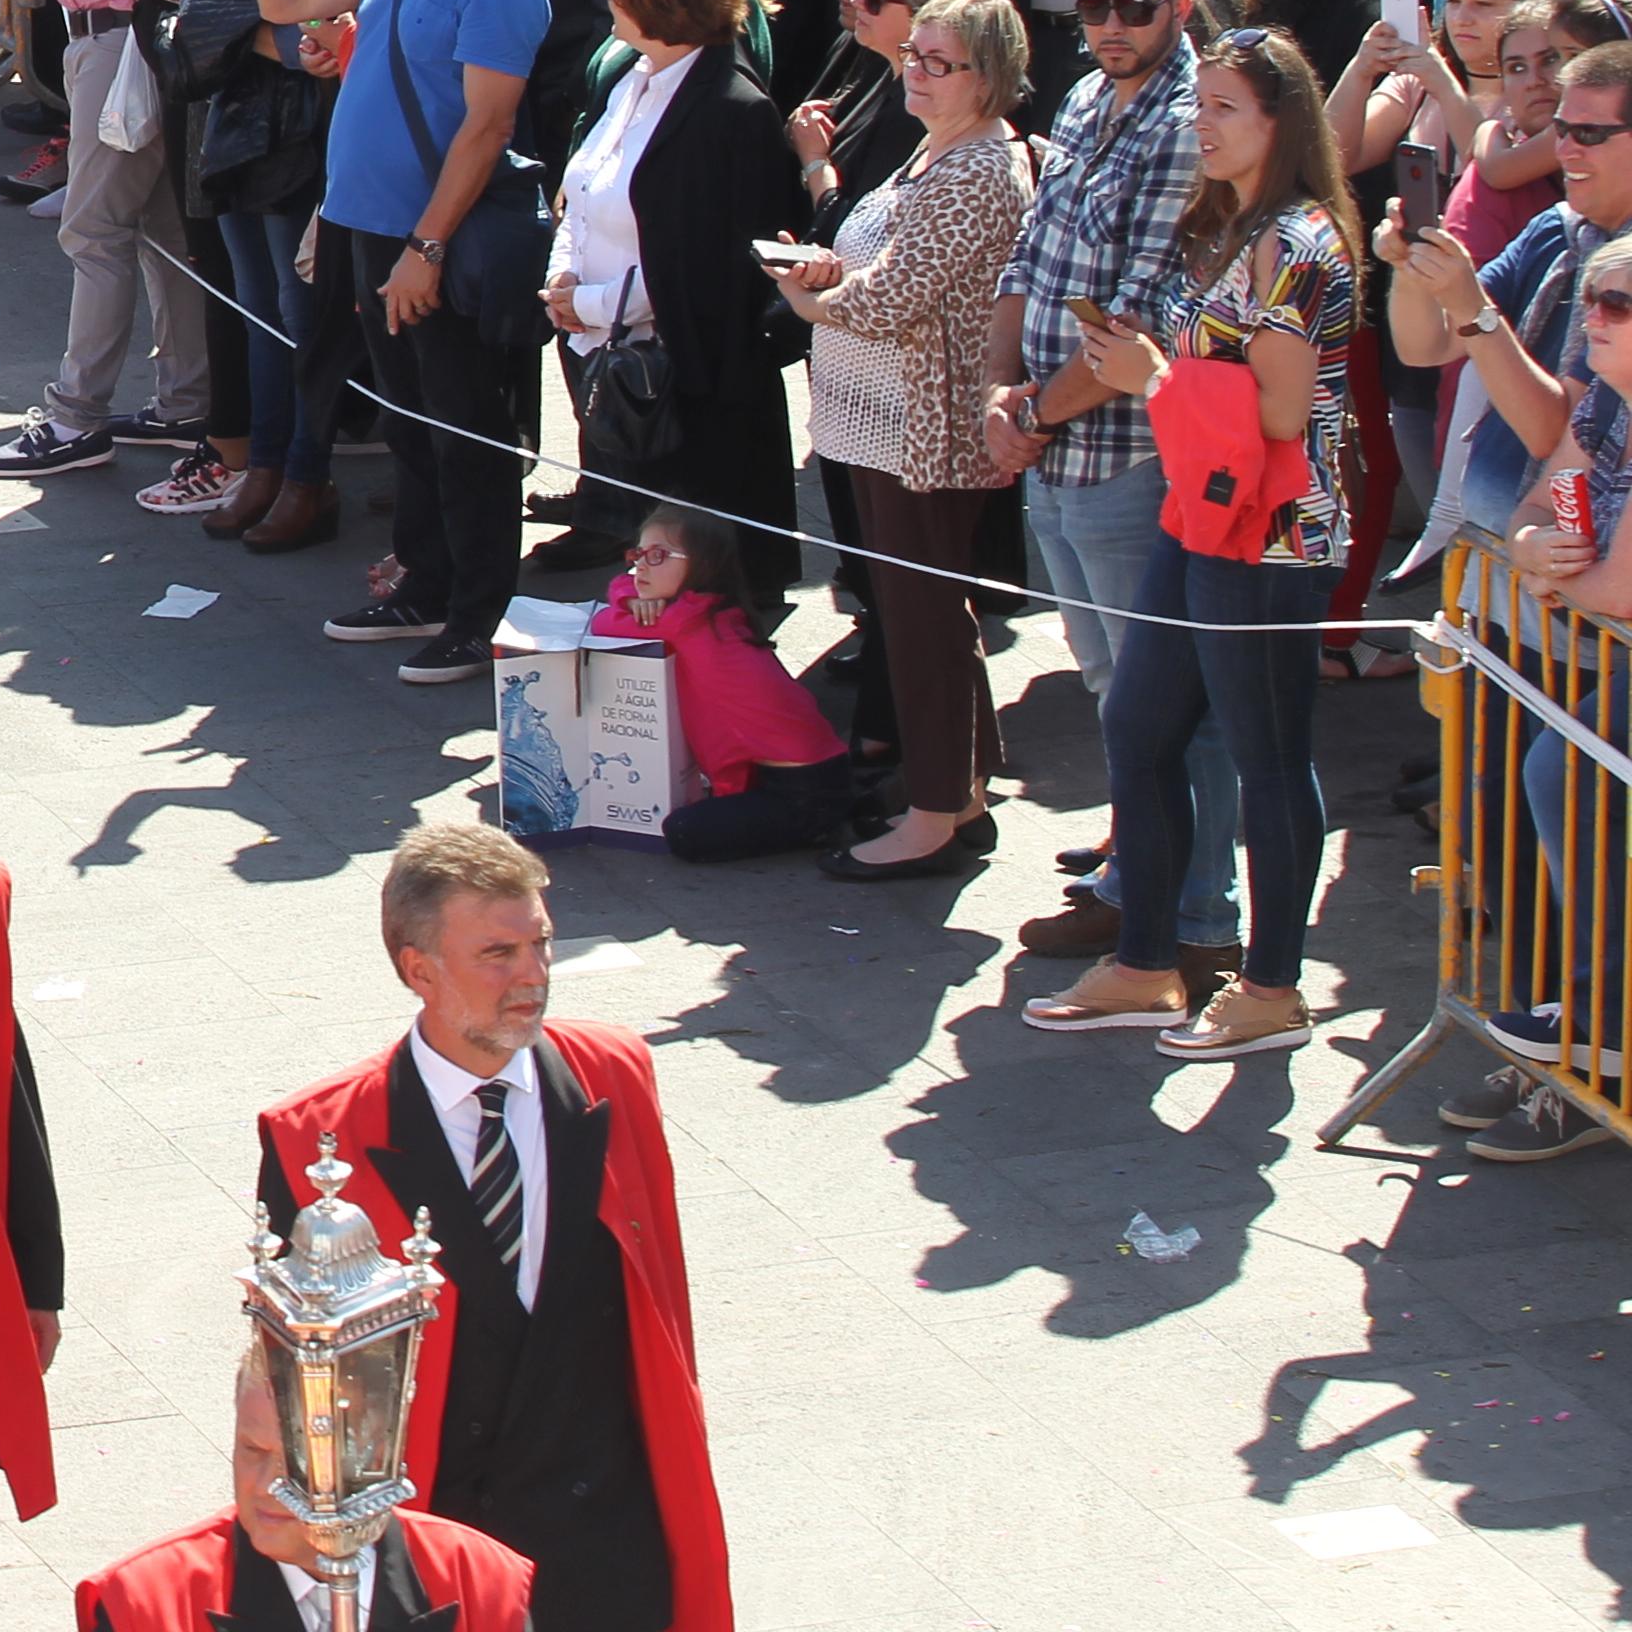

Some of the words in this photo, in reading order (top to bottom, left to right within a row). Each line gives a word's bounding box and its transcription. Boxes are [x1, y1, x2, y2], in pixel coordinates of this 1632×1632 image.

[616, 677, 657, 693] UTILIZE
[616, 694, 623, 704] A
[625, 693, 657, 708] ÁGUA
[601, 706, 617, 720] DE
[618, 708, 658, 724] FORMA
[601, 721, 659, 741] RACIONAL
